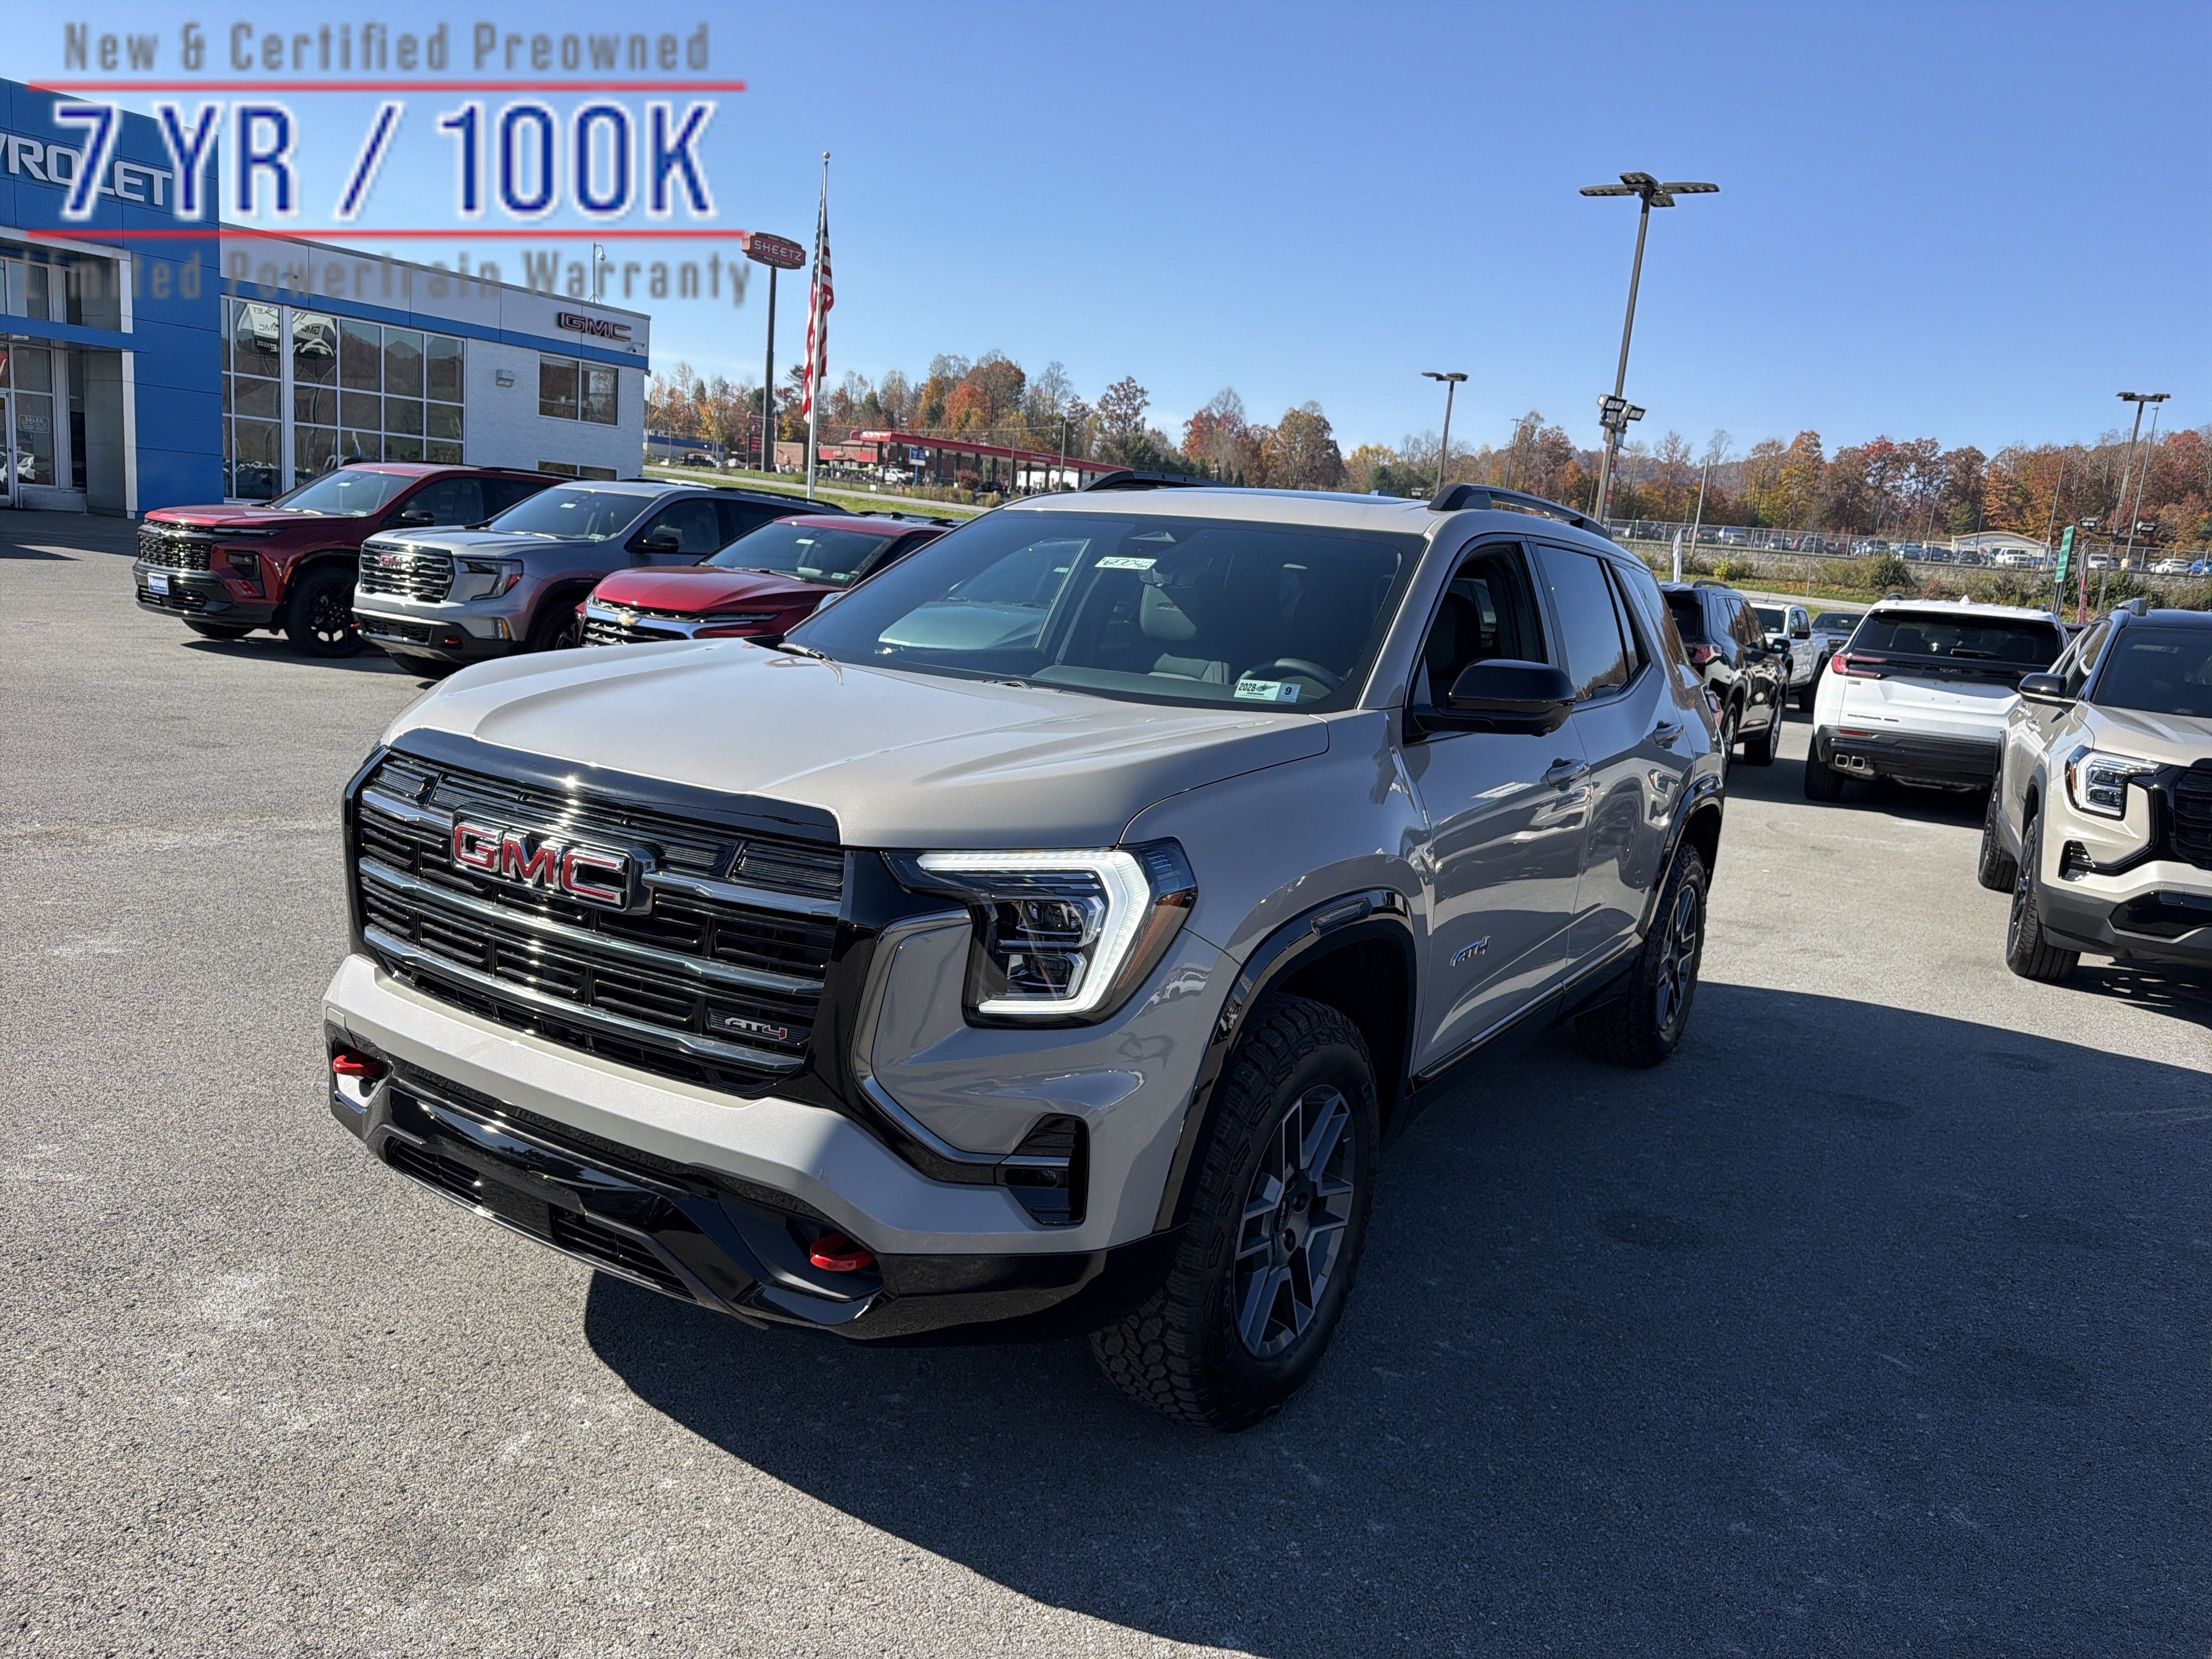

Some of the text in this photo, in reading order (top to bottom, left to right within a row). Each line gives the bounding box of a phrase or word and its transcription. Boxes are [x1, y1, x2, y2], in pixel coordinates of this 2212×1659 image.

[754, 240, 802, 261] SHEETZ
[560, 312, 631, 341] GMC
[1238, 682, 1293, 696] 2028 9
[453, 821, 626, 907] GMC
[724, 1017, 788, 1040] AT4
